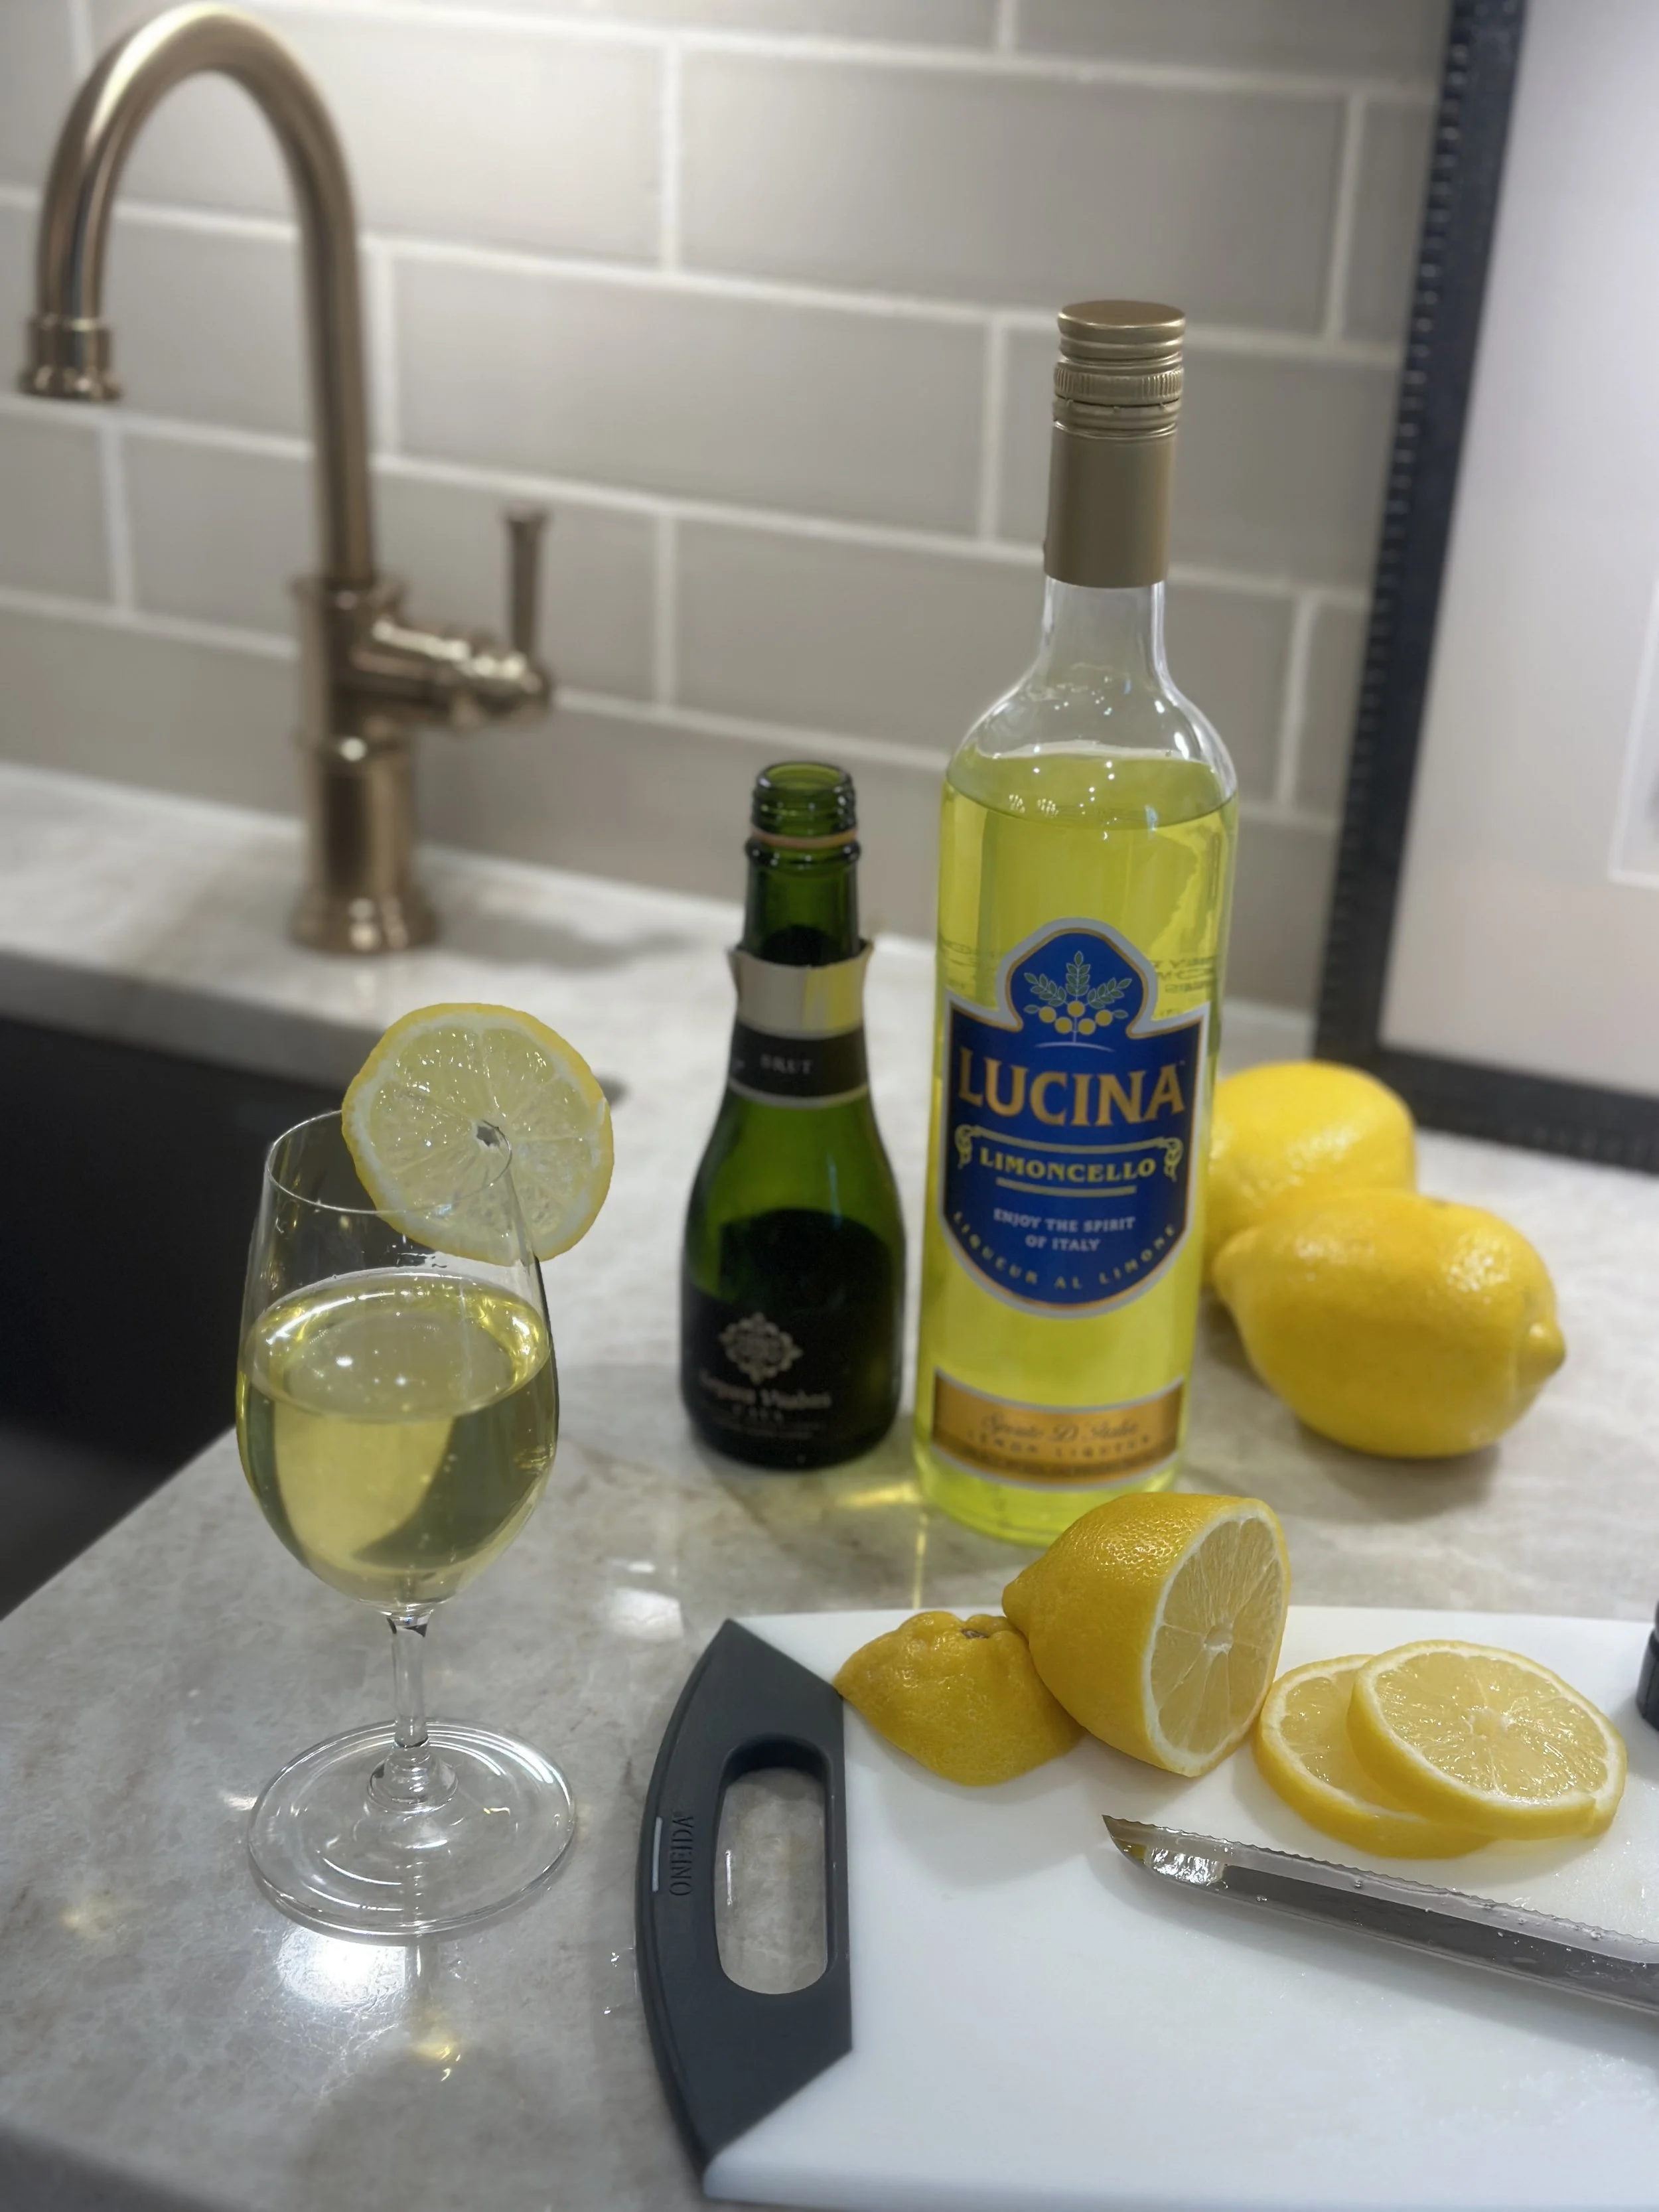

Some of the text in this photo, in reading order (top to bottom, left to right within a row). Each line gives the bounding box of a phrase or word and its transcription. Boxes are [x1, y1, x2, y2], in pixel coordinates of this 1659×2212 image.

[958, 1046, 1186, 1127] LUCINA
[979, 1147, 1157, 1183] LIMONCELLO
[993, 1209, 1135, 1233] ENJOY THE SPIRIT
[1025, 1234, 1102, 1252] OF ITALY
[1054, 1276, 1082, 1290] AL
[669, 1816, 694, 1897] ONEIDA
